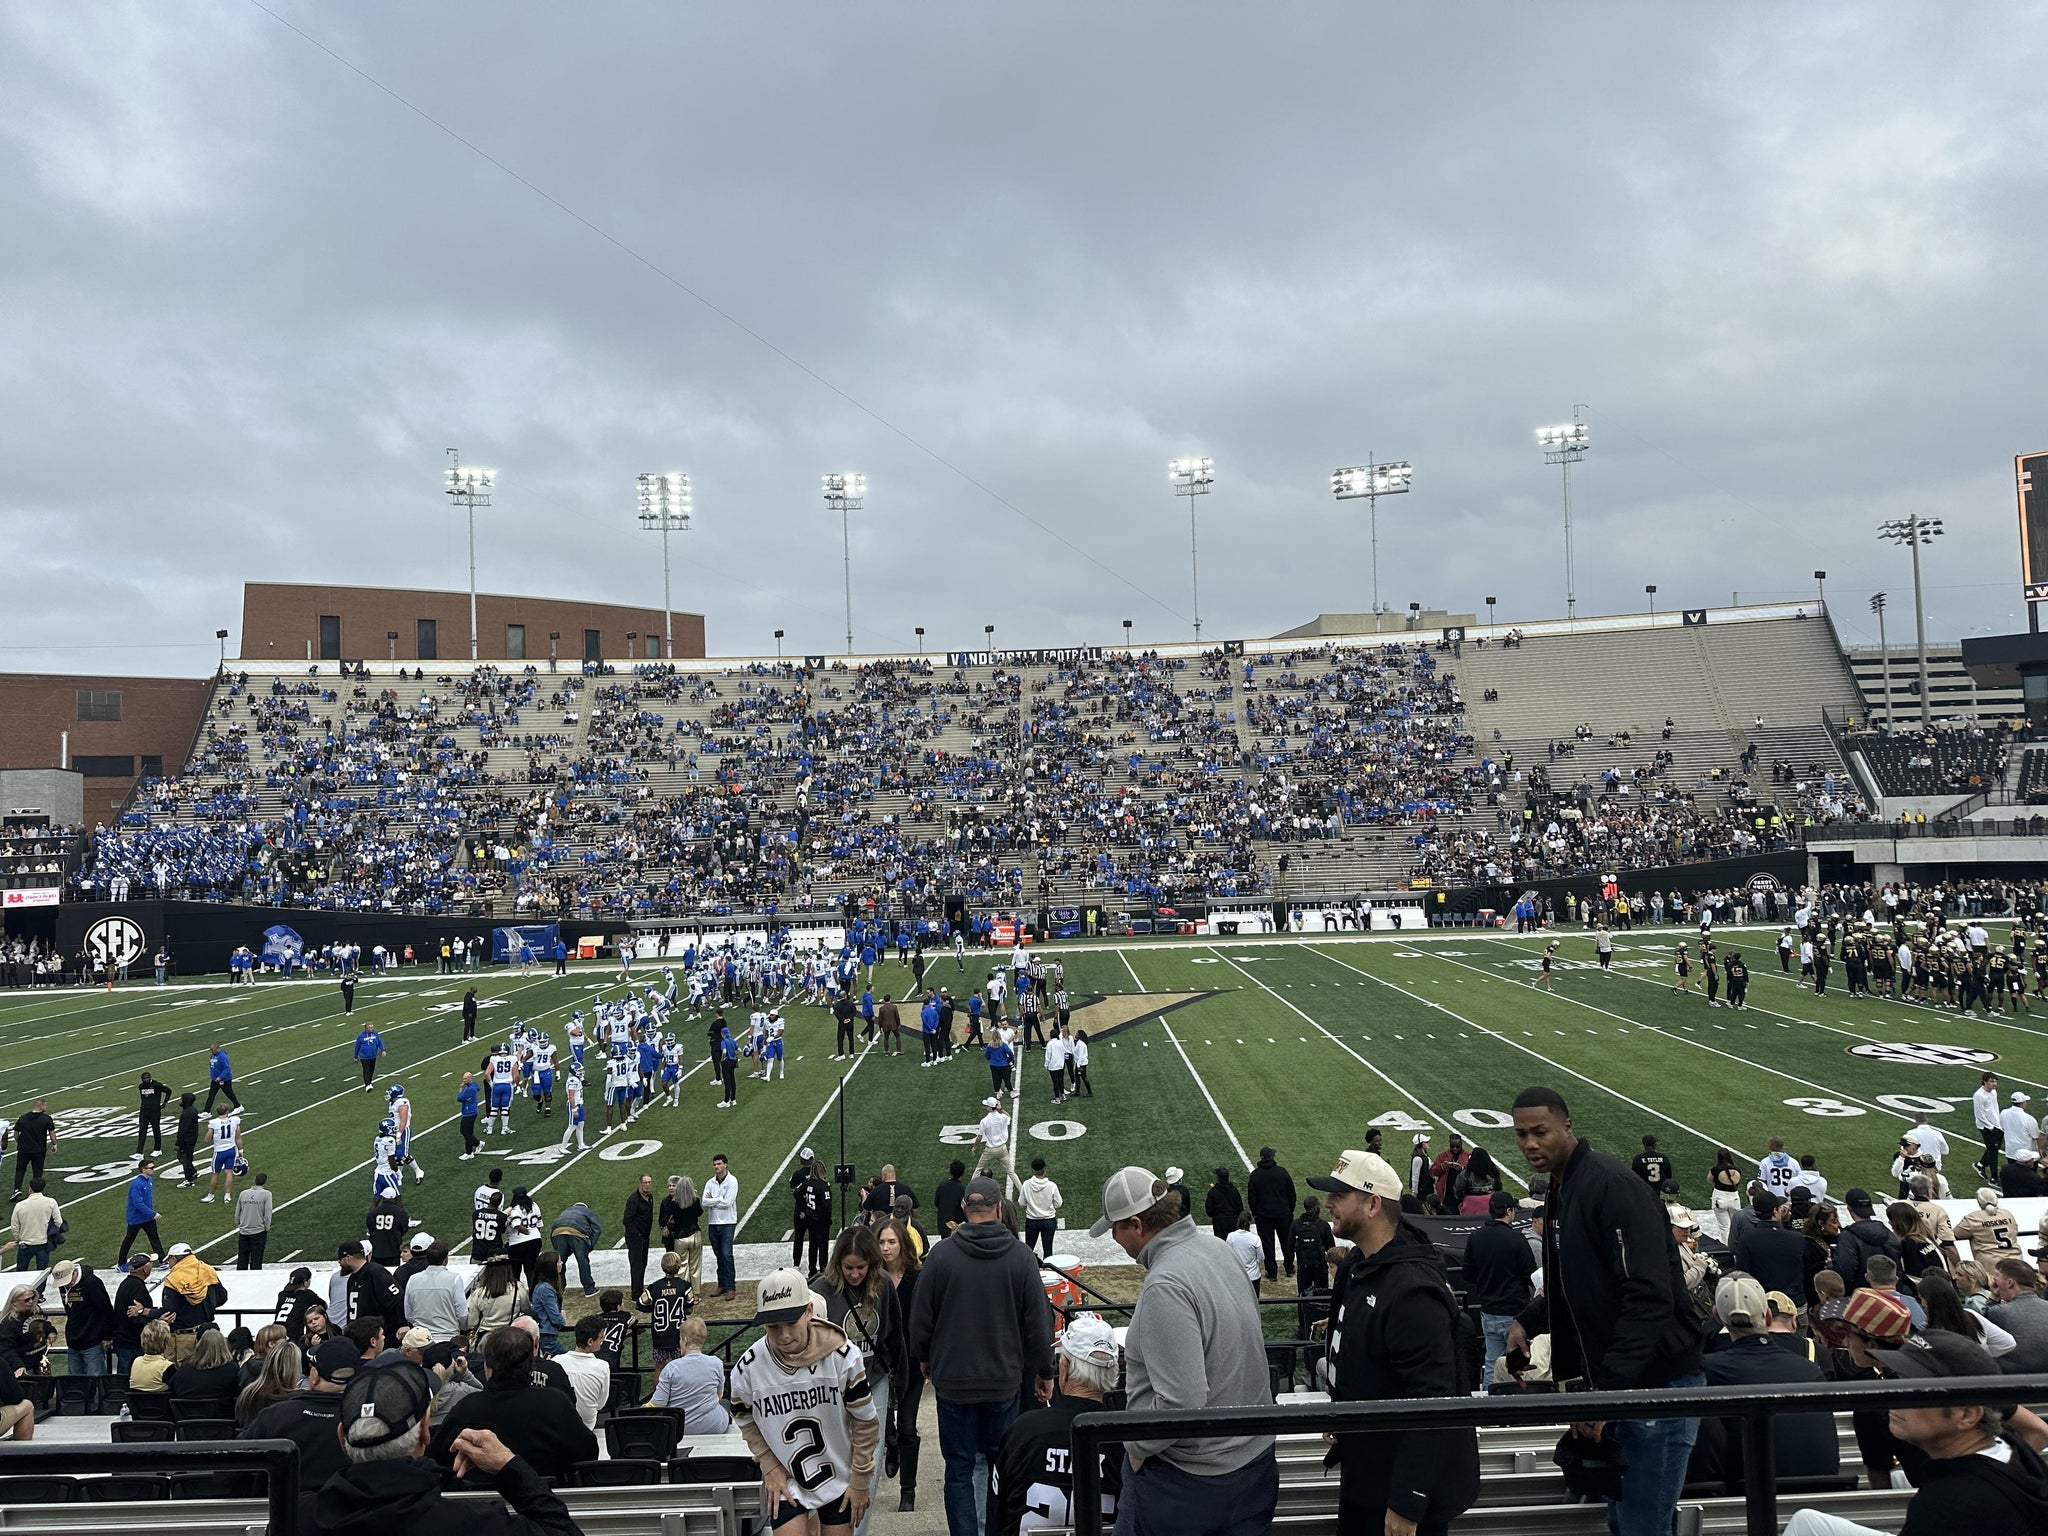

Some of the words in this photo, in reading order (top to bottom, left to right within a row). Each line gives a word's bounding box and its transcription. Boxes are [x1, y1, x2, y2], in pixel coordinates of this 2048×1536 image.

[1688, 613, 1701, 623] V
[809, 659, 821, 668] V
[89, 920, 140, 963] SEC
[614, 1025, 625, 1033] 73
[537, 1054, 548, 1063] 79
[497, 1061, 511, 1073] 69
[616, 1063, 627, 1077] 18
[220, 1124, 232, 1140] 11
[1647, 1163, 1661, 1182] 3
[1770, 1168, 1792, 1187] 39
[375, 1214, 394, 1230] 99
[475, 1219, 498, 1240] 96
[1982, 1218, 2008, 1228] HOSKINS
[1993, 1227, 2012, 1249] 5
[388, 1284, 400, 1295] 5
[661, 1288, 677, 1297] MANN
[762, 1286, 793, 1306] Vanderbilt
[276, 1303, 293, 1322] 2
[349, 1292, 359, 1320] 5
[653, 1296, 686, 1332] 94
[808, 1364, 818, 1375] V
[753, 1386, 839, 1419] VANDERBILT
[781, 1416, 836, 1492] 2
